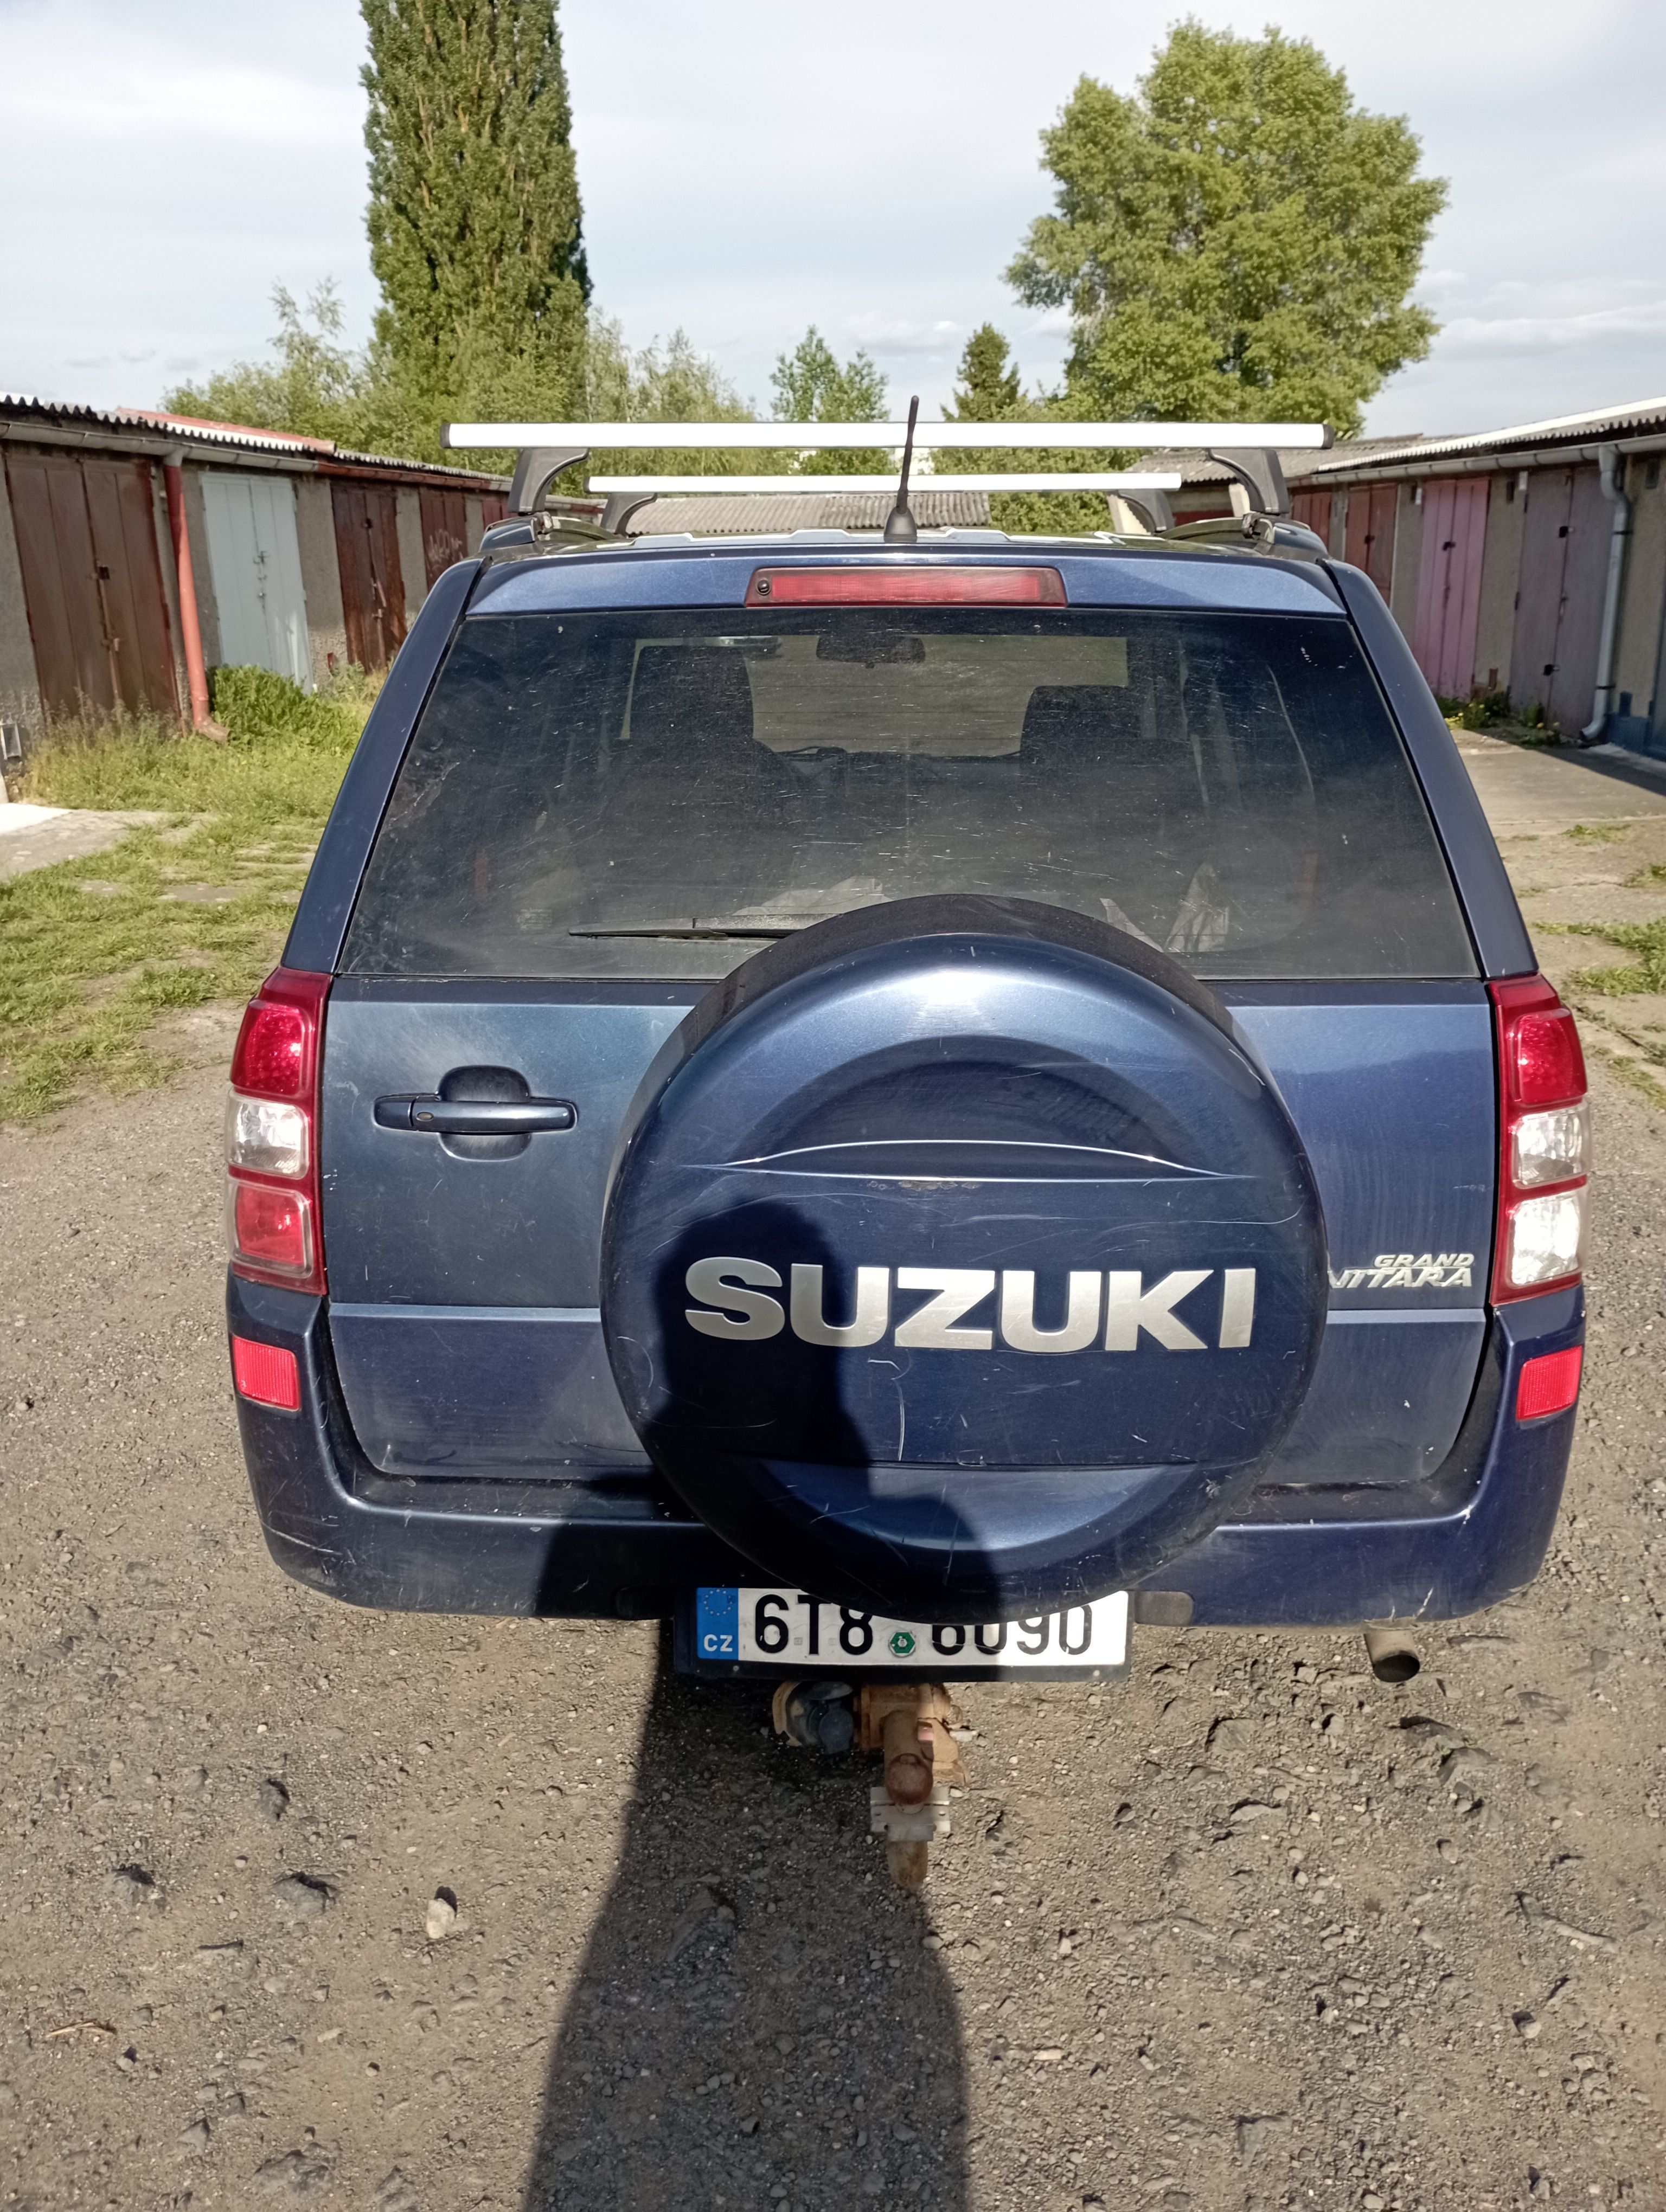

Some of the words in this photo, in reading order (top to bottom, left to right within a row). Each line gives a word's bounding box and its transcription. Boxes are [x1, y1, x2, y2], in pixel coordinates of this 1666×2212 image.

[1374, 1253, 1475, 1268] GRAND
[685, 1256, 1257, 1353] SUZUKI
[703, 1634, 733, 1652] CZ
[755, 1593, 873, 1656] 6T8
